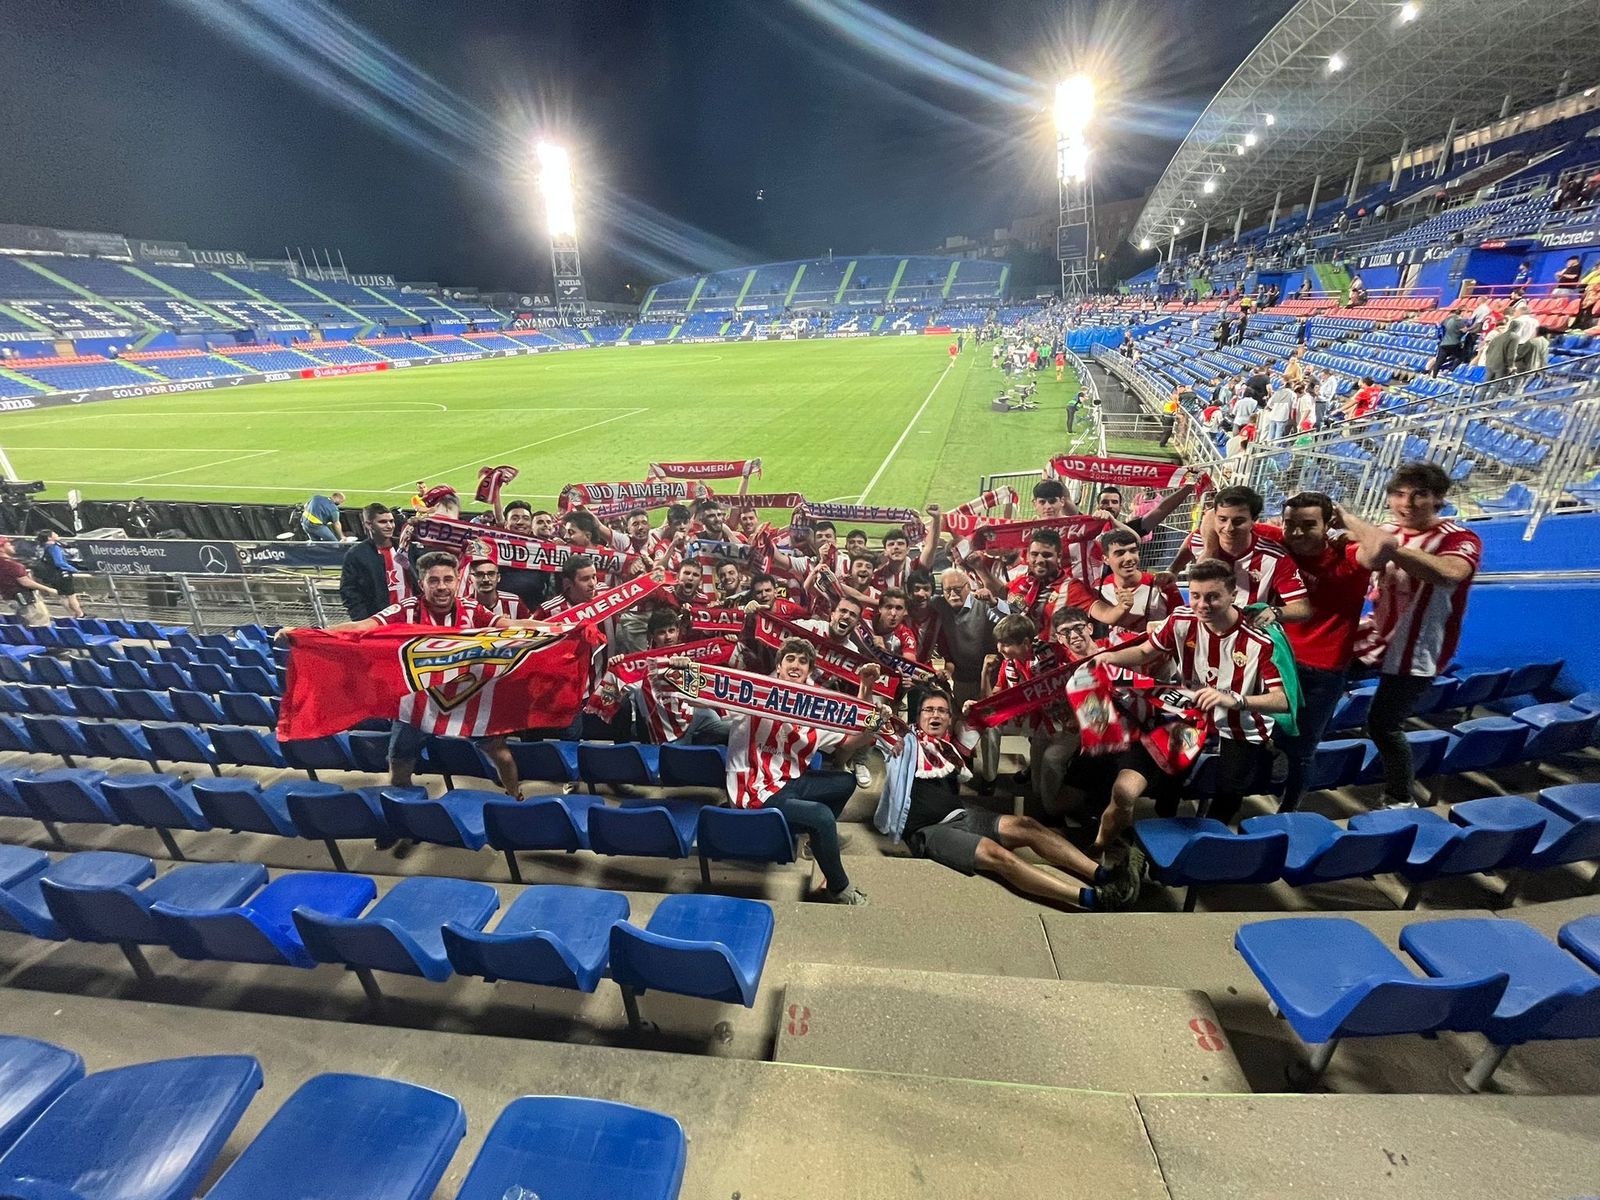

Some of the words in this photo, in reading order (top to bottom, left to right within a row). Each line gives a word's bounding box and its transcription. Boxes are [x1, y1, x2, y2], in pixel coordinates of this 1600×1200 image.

[1542, 230, 1595, 247] Motoreto
[192, 251, 247, 265] LUJISA
[351, 275, 395, 287] LUJISA
[112, 388, 143, 399] SOLO
[145, 385, 168, 395] POR
[170, 381, 214, 392] DEPORTE
[669, 465, 685, 473] UD
[1063, 460, 1086, 471] UD
[1090, 462, 1158, 477] ALMERÍA
[587, 485, 614, 500] UD
[947, 513, 969, 531] UD
[90, 544, 166, 557] Mercedes-Benz
[252, 549, 286, 561] LaLiga
[499, 543, 530, 563] UD
[97, 561, 130, 573] Citycar
[133, 561, 150, 573] Sur
[764, 687, 858, 727] ALMERIA
[787, 1003, 811, 1037] 8
[1188, 1017, 1225, 1052] 8
